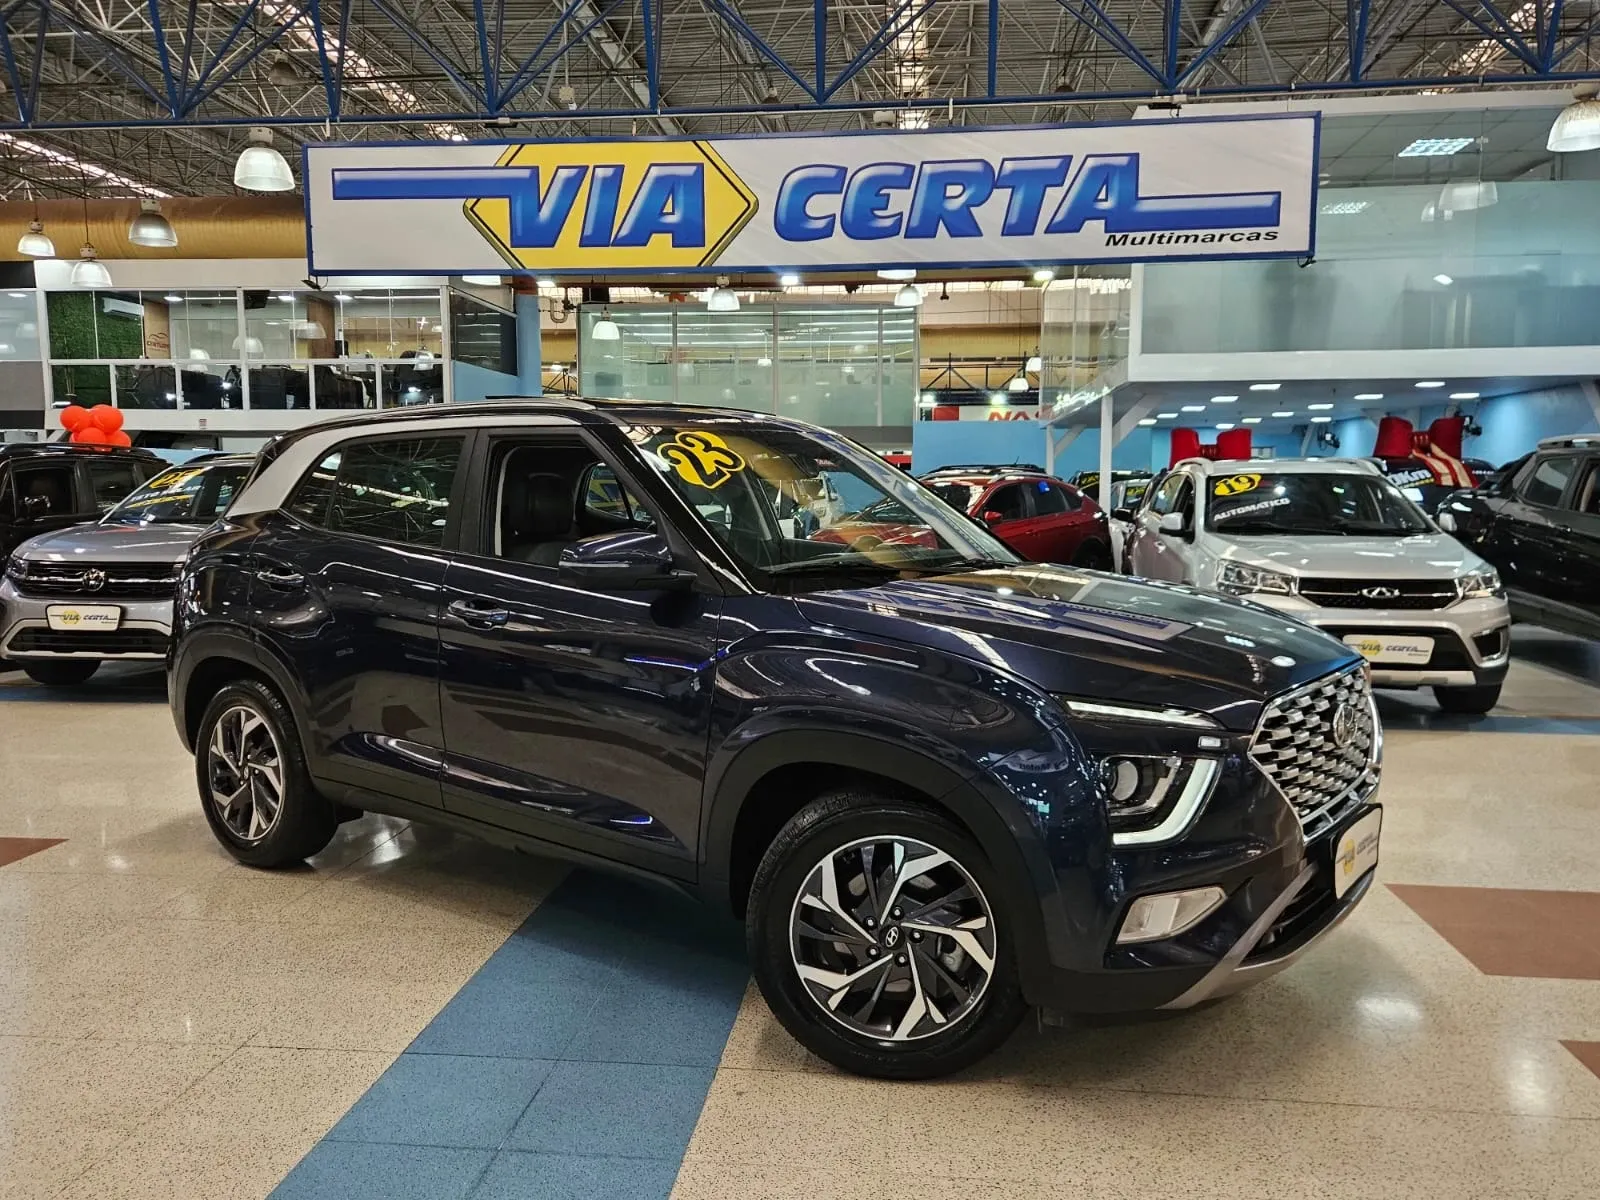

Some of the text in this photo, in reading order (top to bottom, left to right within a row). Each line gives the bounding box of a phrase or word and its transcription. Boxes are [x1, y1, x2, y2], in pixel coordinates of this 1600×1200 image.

[495, 153, 1140, 248] VIA CERTA
[1105, 229, 1280, 248] Multimarcas
[660, 432, 740, 486] 23
